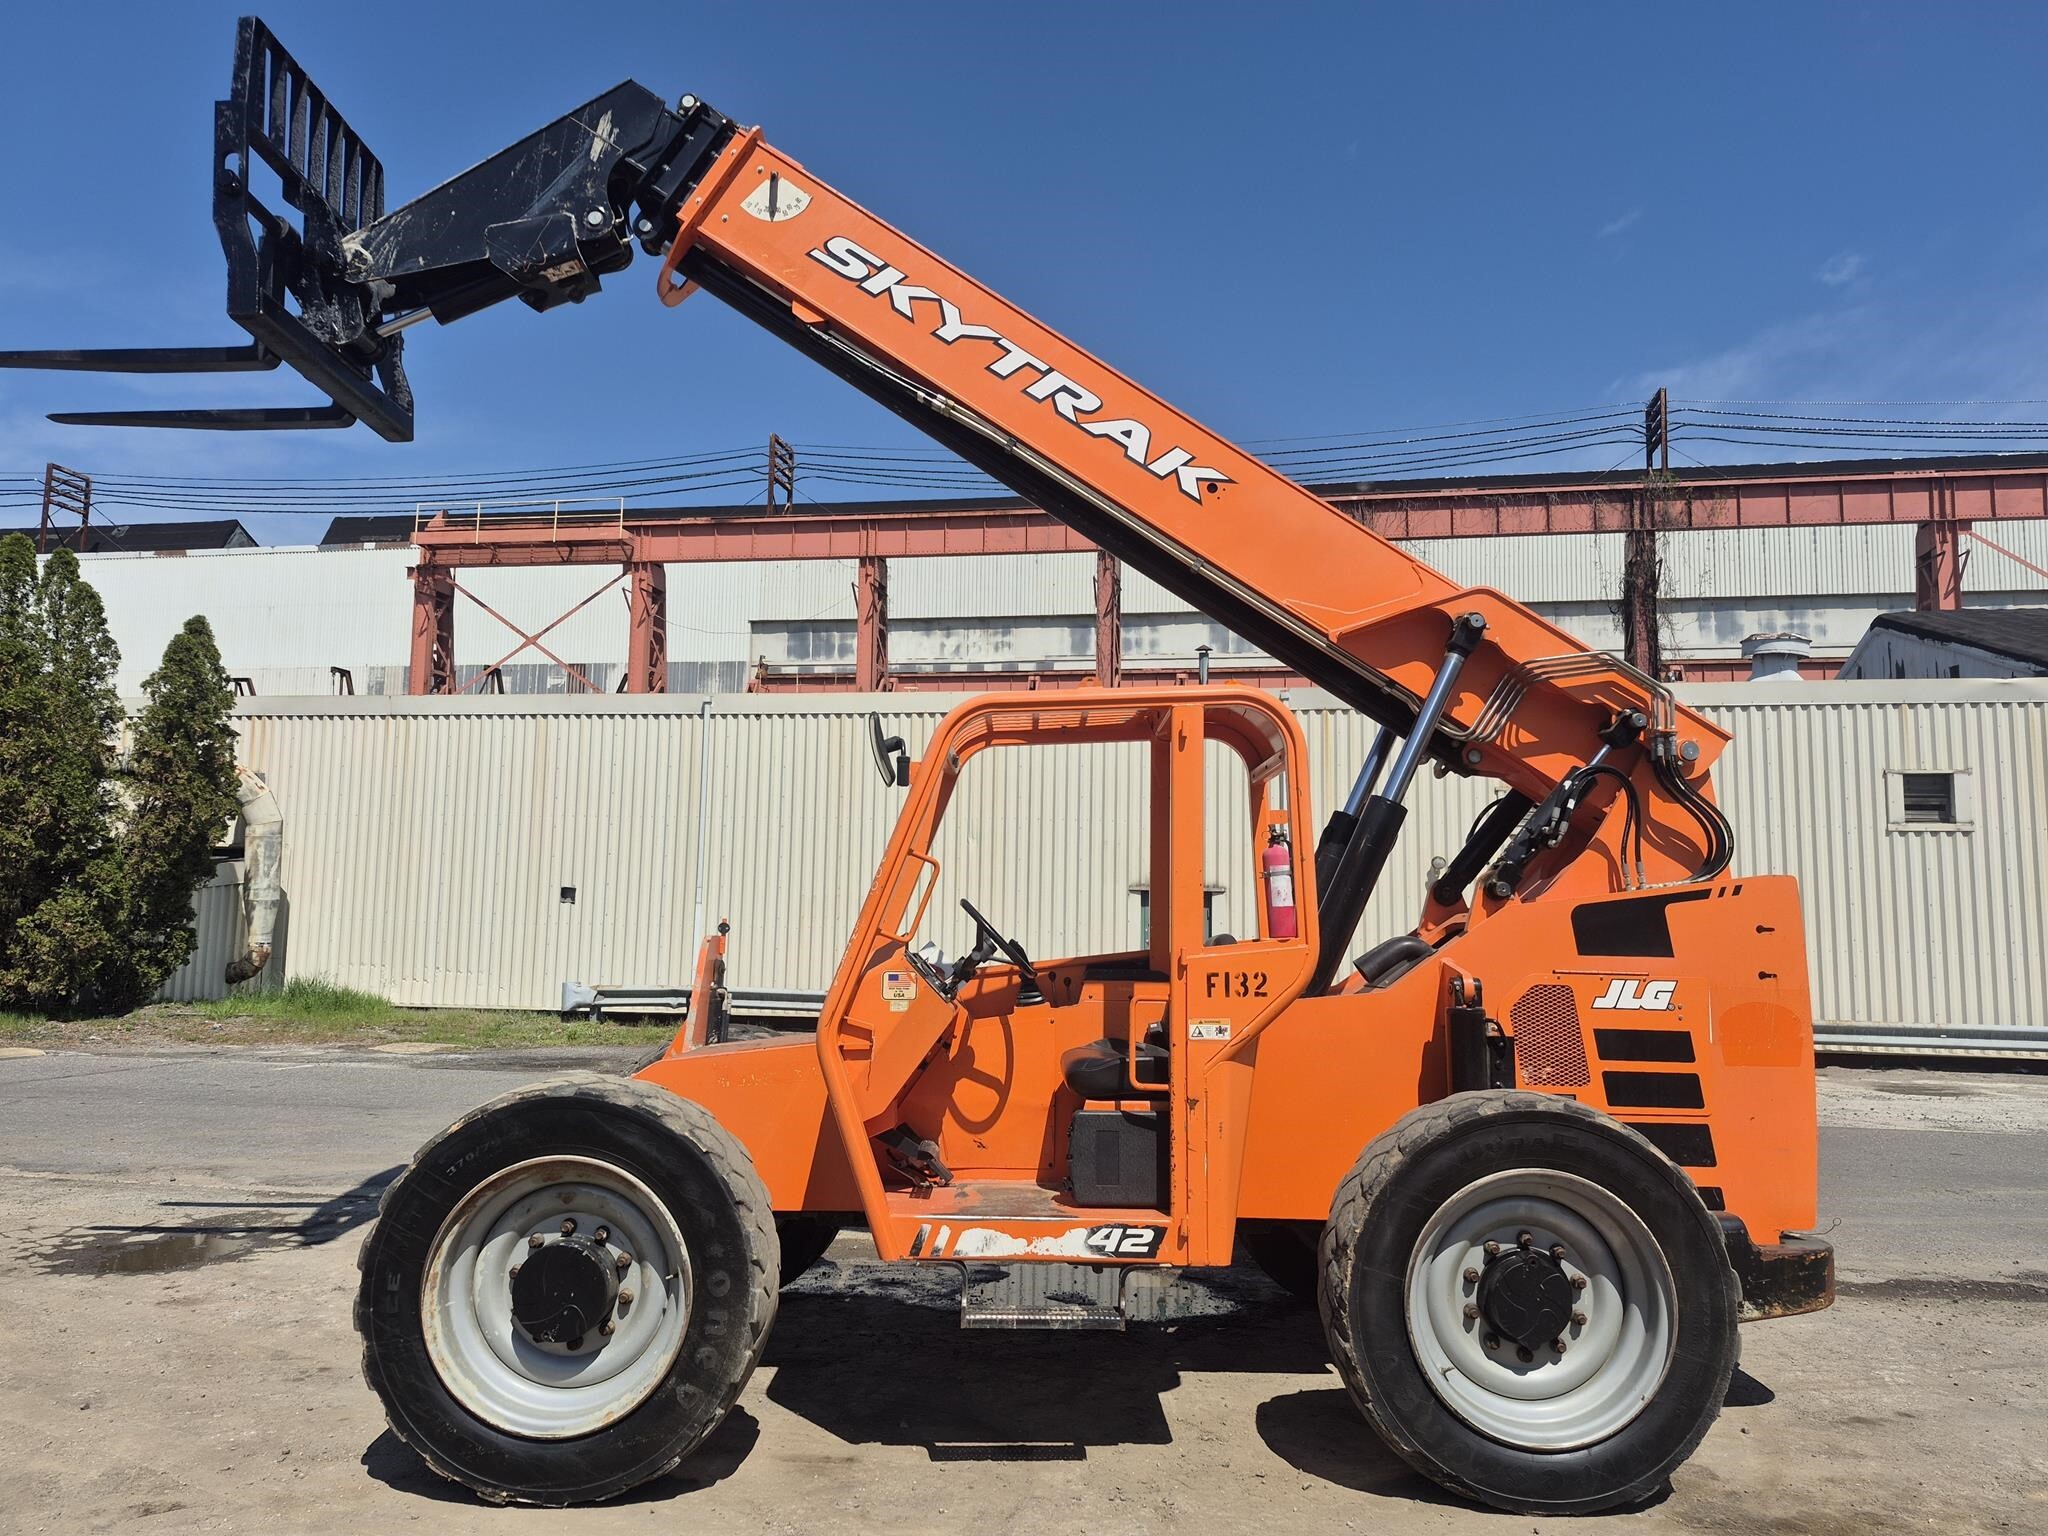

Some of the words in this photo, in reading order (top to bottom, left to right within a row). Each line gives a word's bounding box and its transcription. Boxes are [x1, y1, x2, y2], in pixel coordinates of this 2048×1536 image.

[805, 235, 1238, 506] SKYTRAK
[1206, 971, 1268, 998] F132
[1591, 978, 1678, 1011] JLG
[1087, 1228, 1155, 1253] 42
